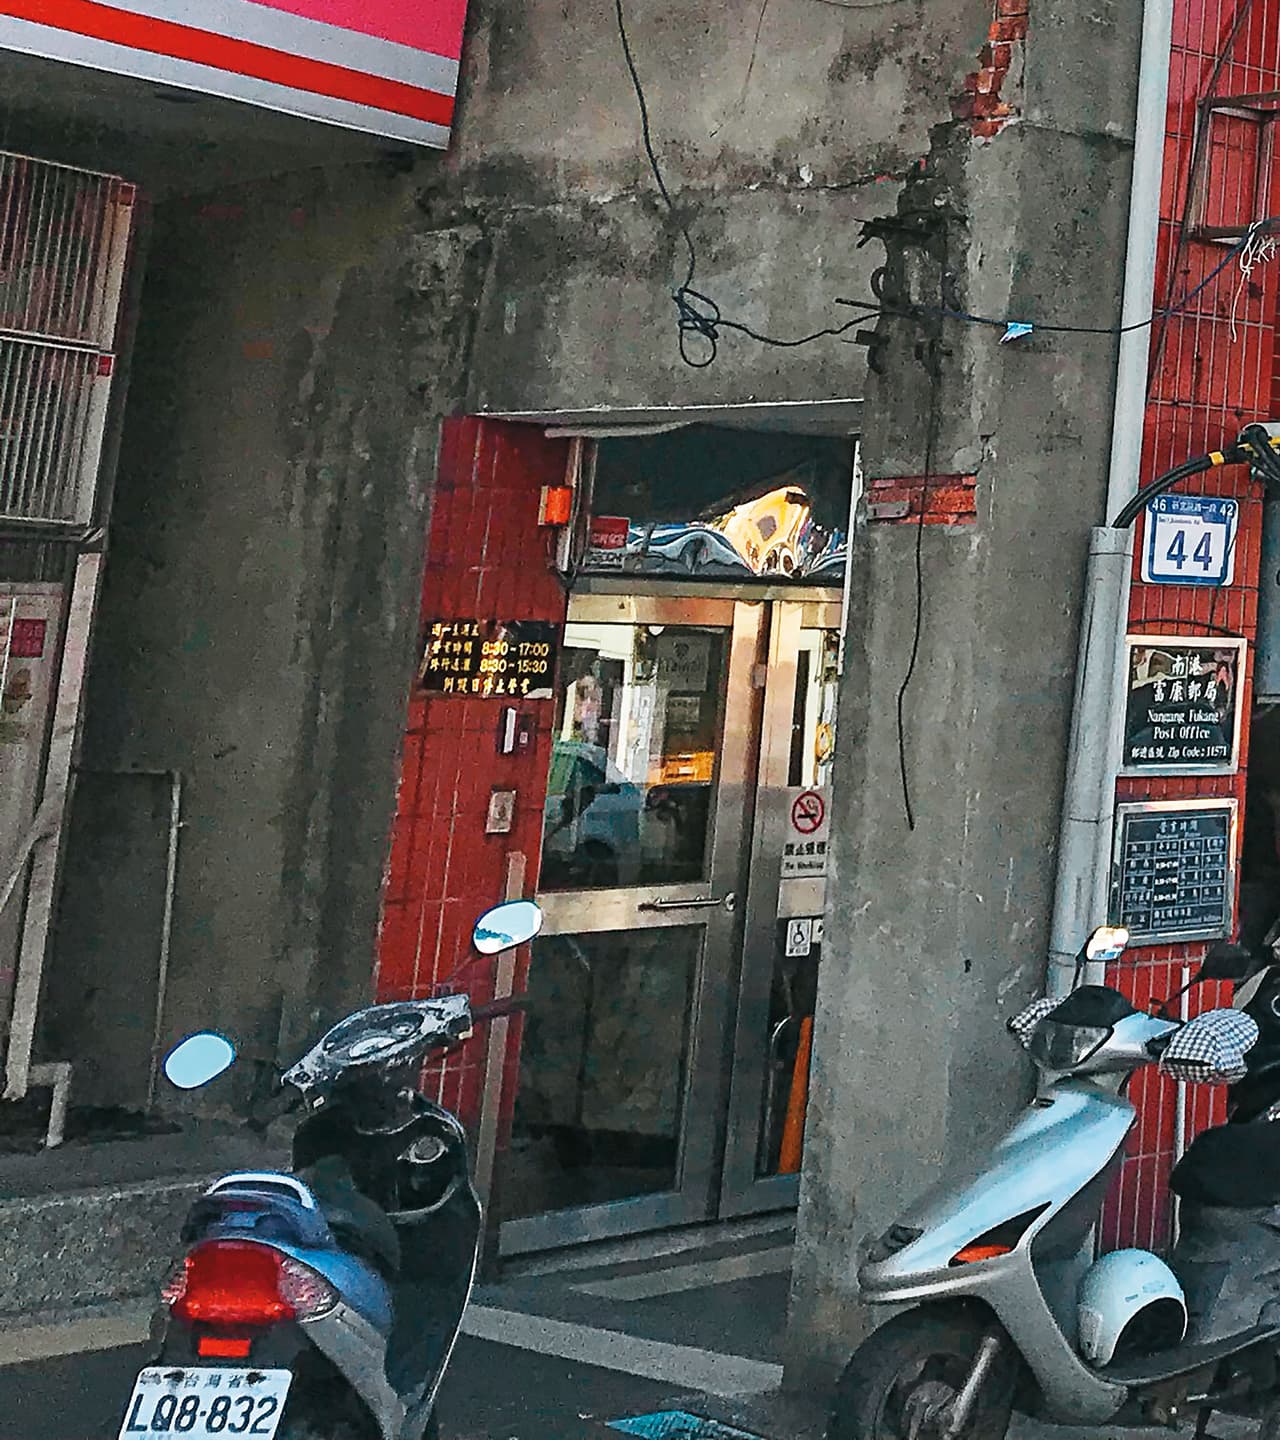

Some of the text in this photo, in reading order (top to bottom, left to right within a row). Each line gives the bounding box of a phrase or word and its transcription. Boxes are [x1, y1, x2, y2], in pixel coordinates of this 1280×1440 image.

[1151, 498, 1168, 512] 46
[1219, 503, 1235, 517] 42
[1165, 529, 1213, 572] 44
[1171, 654, 1203, 677] 南港
[1152, 679, 1218, 703] 富康郵局
[1152, 725, 1211, 740] Post Office
